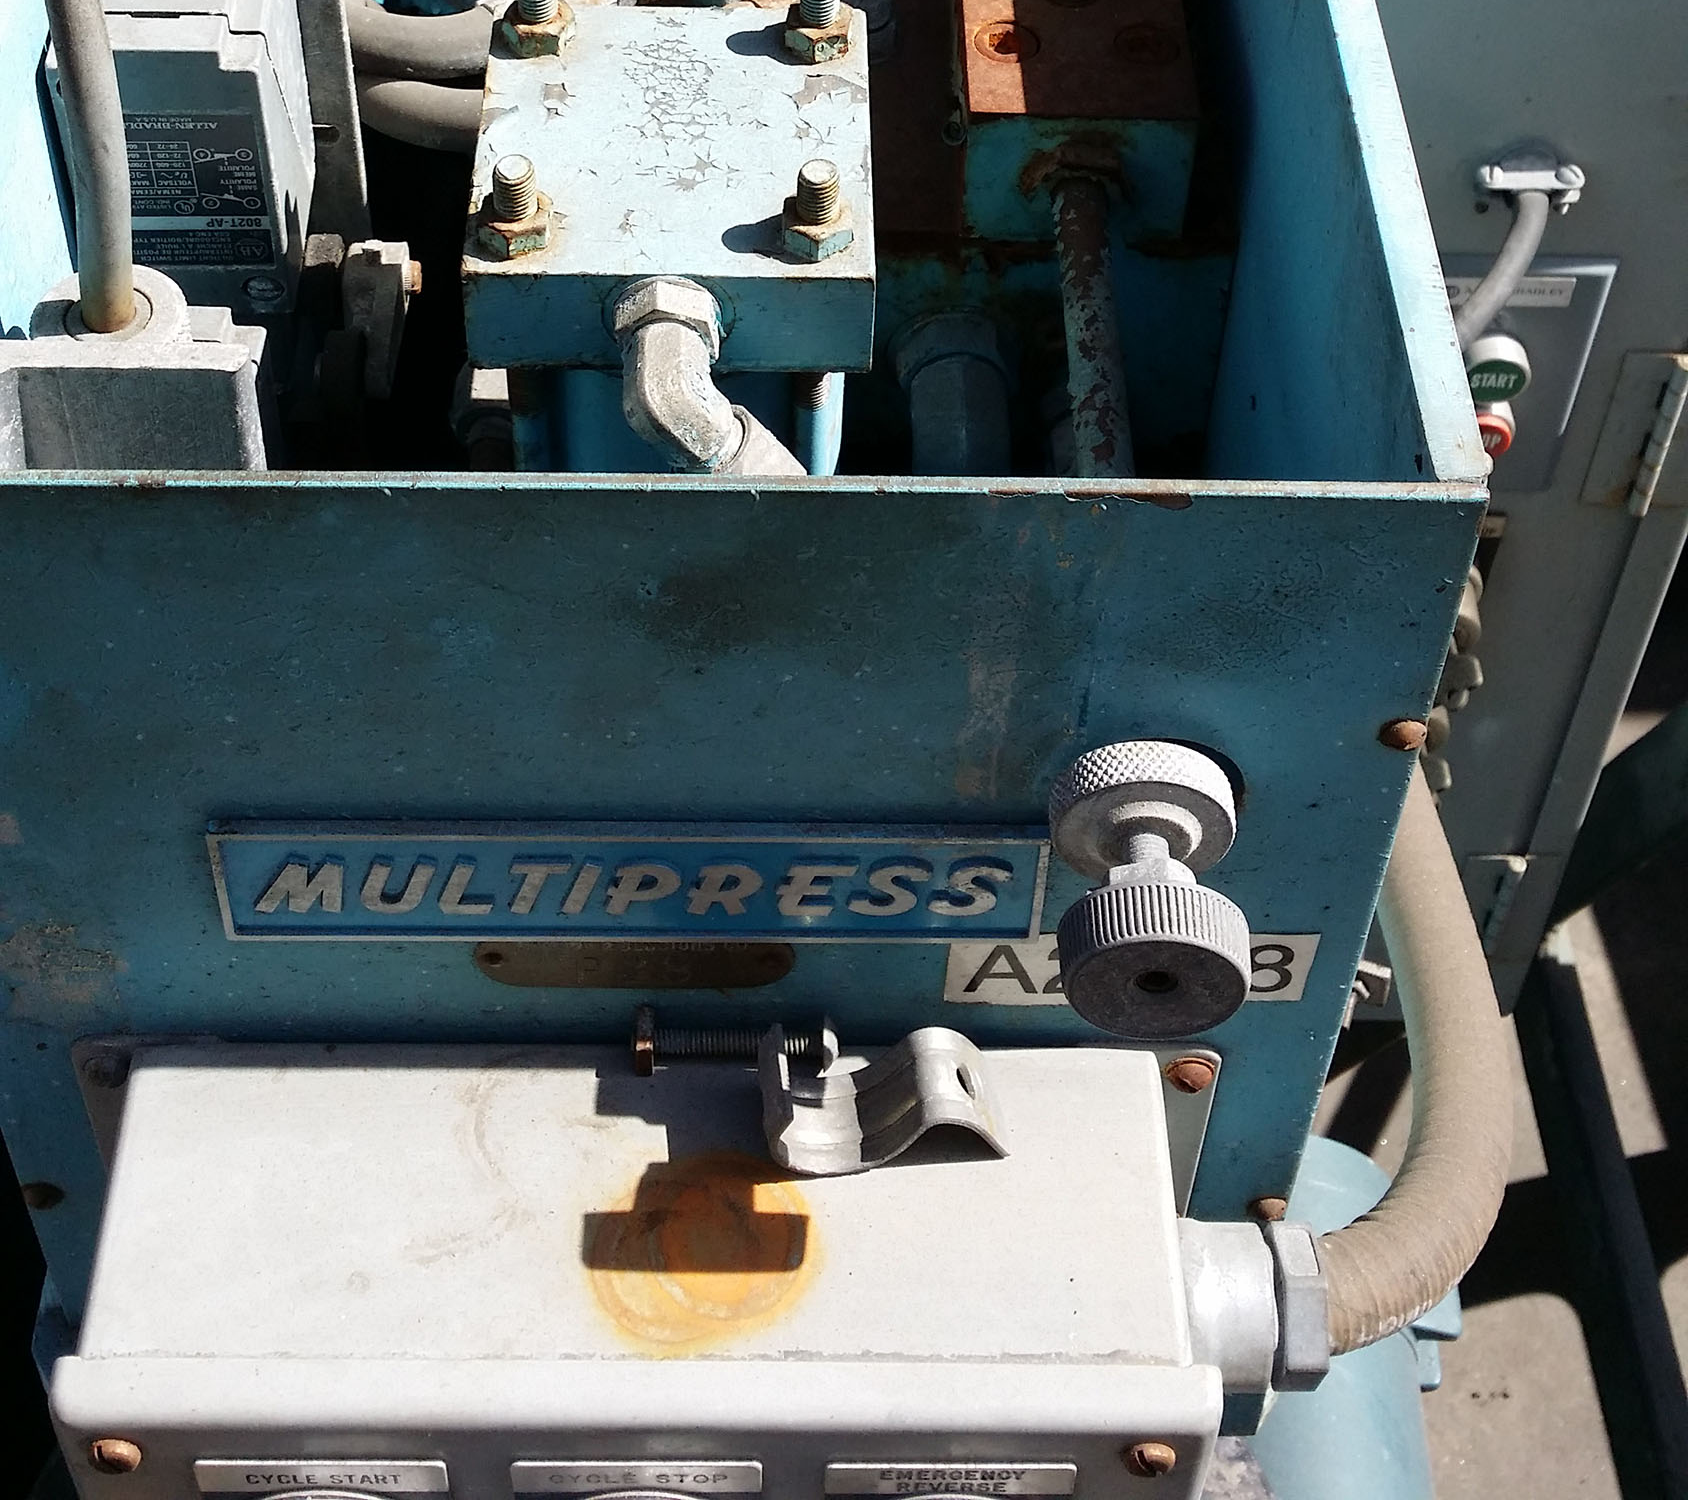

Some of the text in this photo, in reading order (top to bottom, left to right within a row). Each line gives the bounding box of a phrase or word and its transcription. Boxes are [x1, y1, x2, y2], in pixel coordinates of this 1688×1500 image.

[206, 218, 262, 227] 802T-AP
[1470, 372, 1519, 389] START
[252, 854, 1014, 918] MULTIPRESS
[245, 1473, 402, 1486] CYCLE START
[548, 1473, 728, 1485] CYCLE STOP
[879, 1470, 1027, 1481] EMERGENCY
[897, 1482, 1007, 1493] REVERSE
